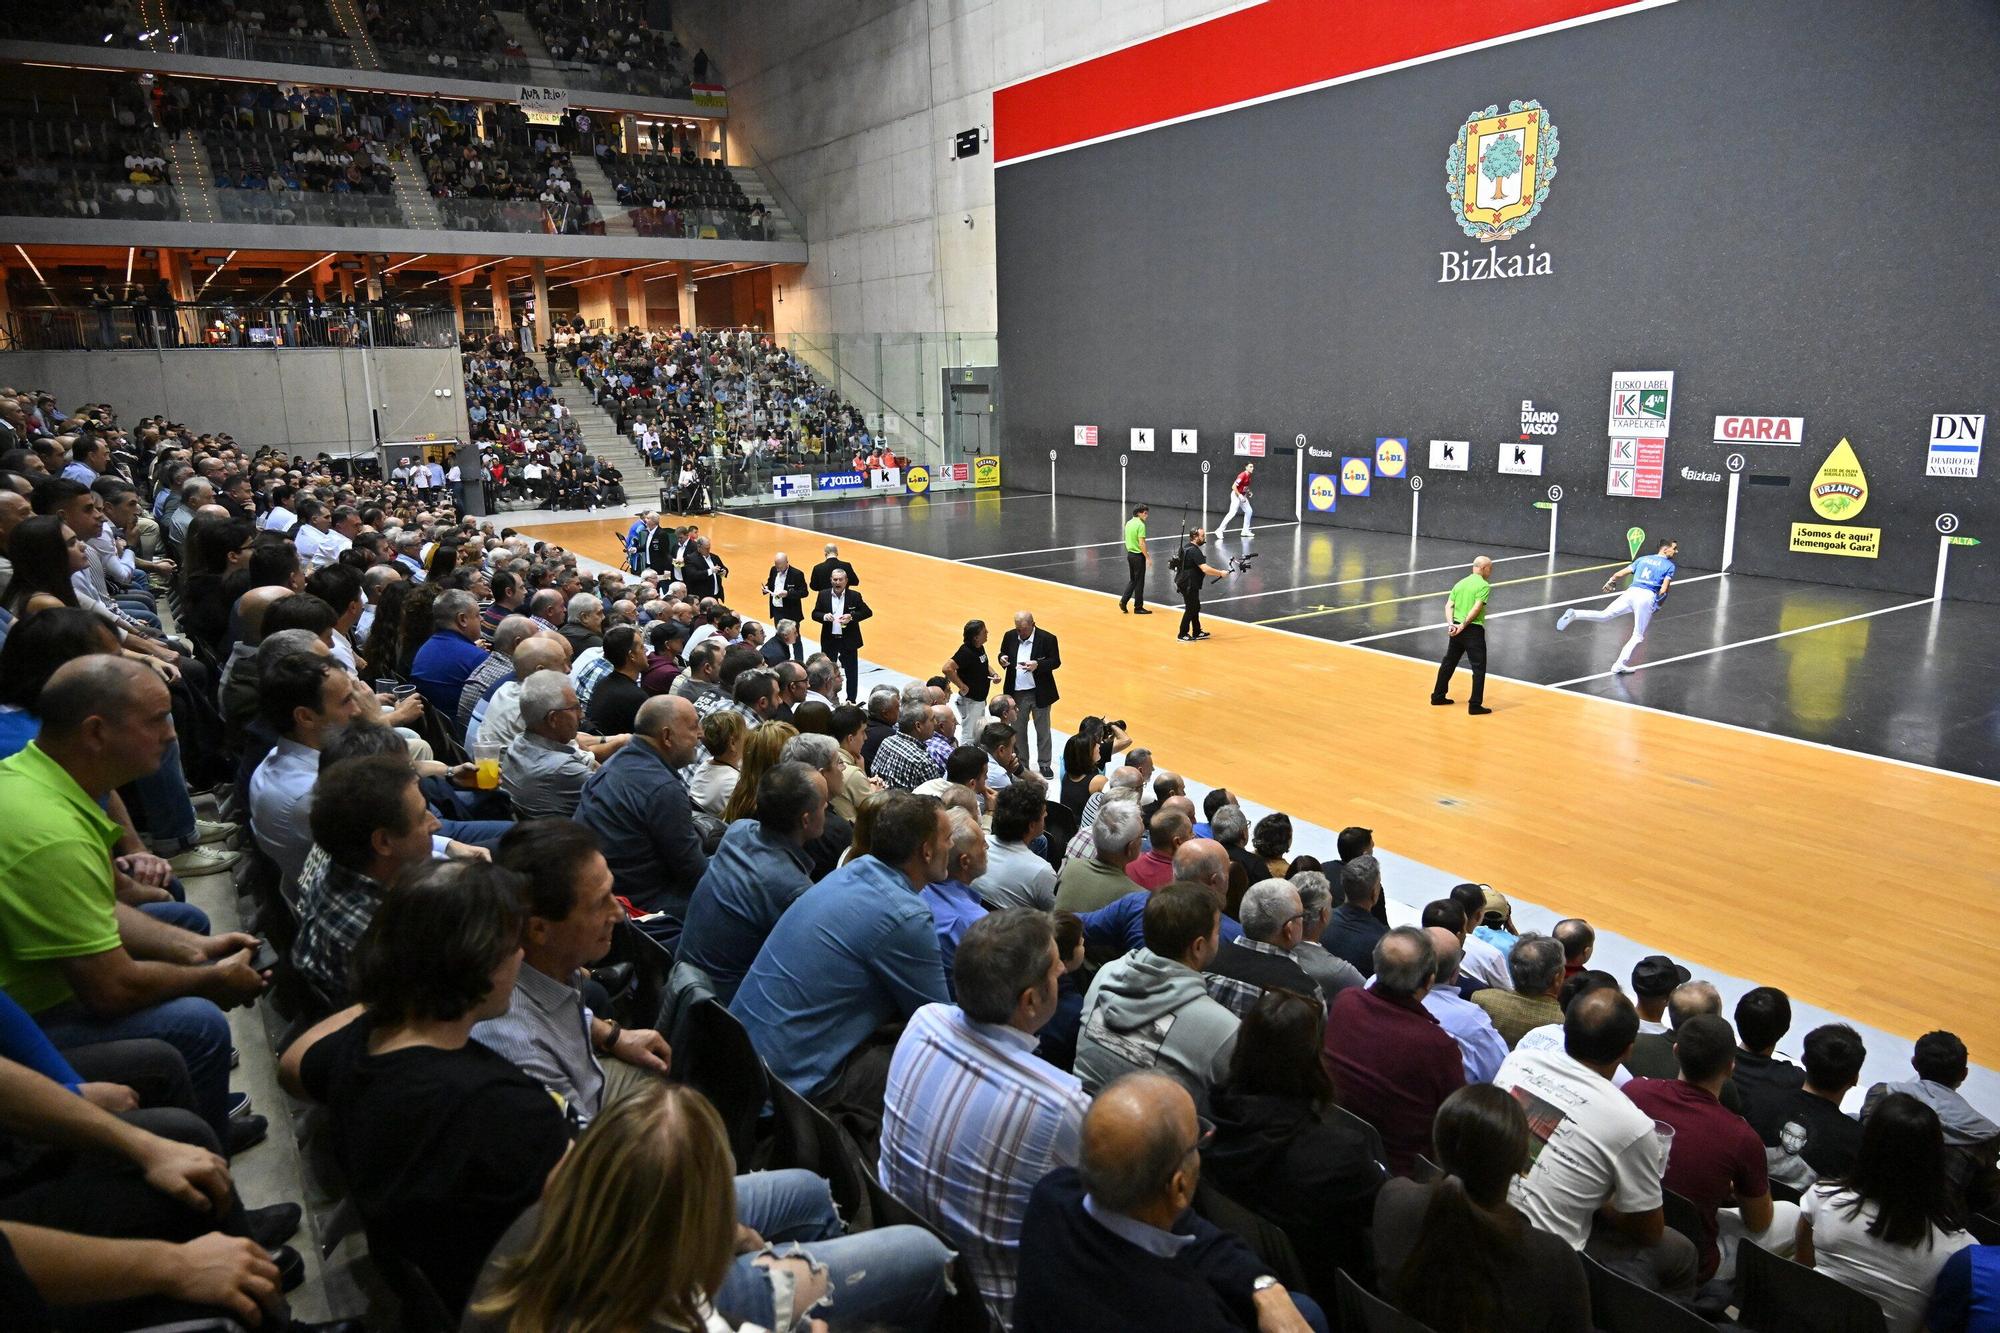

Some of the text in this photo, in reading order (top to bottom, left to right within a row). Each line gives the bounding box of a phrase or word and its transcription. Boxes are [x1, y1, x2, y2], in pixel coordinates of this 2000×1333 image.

[520, 87, 540, 100] AUPA
[1438, 243, 1553, 282] Bizkaia
[1614, 380, 1668, 390] EUSKO LABEL
[1521, 400, 1535, 411] EL
[1521, 411, 1559, 423] DIARIO
[1521, 423, 1557, 435] VASCO
[1613, 419, 1666, 429] TXAPELKETA
[1723, 417, 1791, 440] GARA
[1933, 416, 1981, 440] DN
[1931, 457, 1976, 465] DIARIO DE
[1687, 470, 1721, 482] Bizkaia
[1930, 466, 1975, 475] NAVARRA
[1817, 484, 1861, 497] URZANTE
[1797, 528, 1873, 543] ¡Somos de aquí!
[1793, 537, 1876, 552] Hemengoak Gara!
